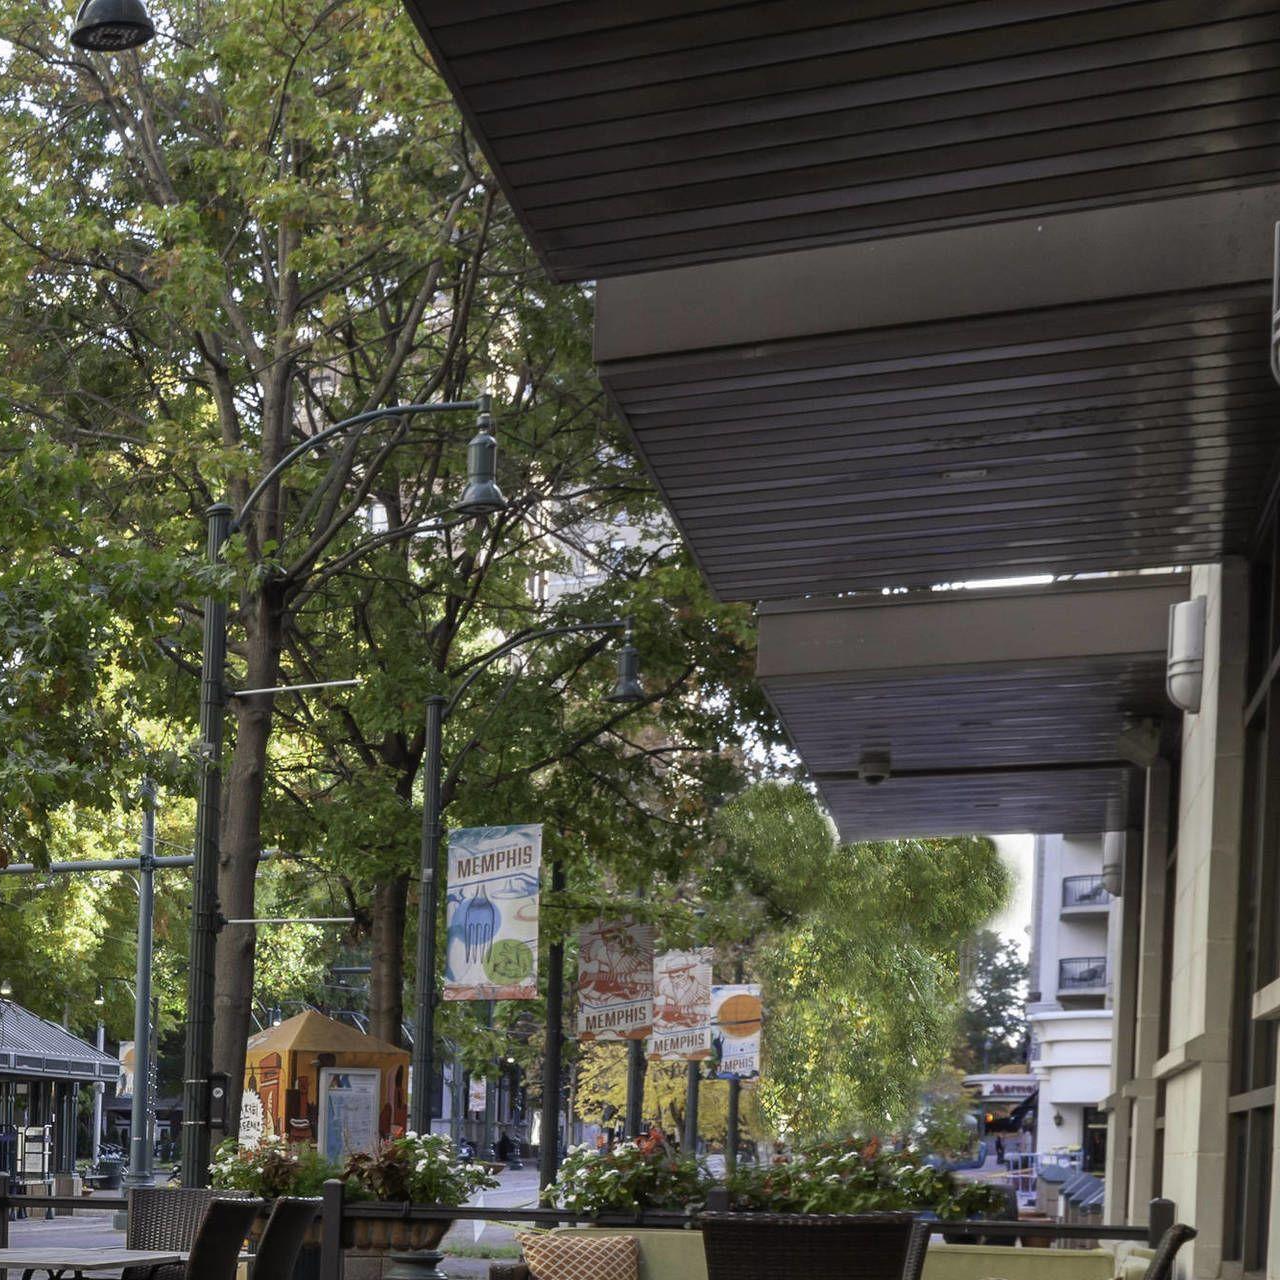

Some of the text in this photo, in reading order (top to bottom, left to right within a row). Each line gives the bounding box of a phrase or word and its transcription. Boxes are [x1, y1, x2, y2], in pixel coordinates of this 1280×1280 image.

[457, 845, 533, 879] MEMPHIS
[585, 1006, 647, 1031] MEMPHIS
[654, 1033, 705, 1053] MEMPHIS
